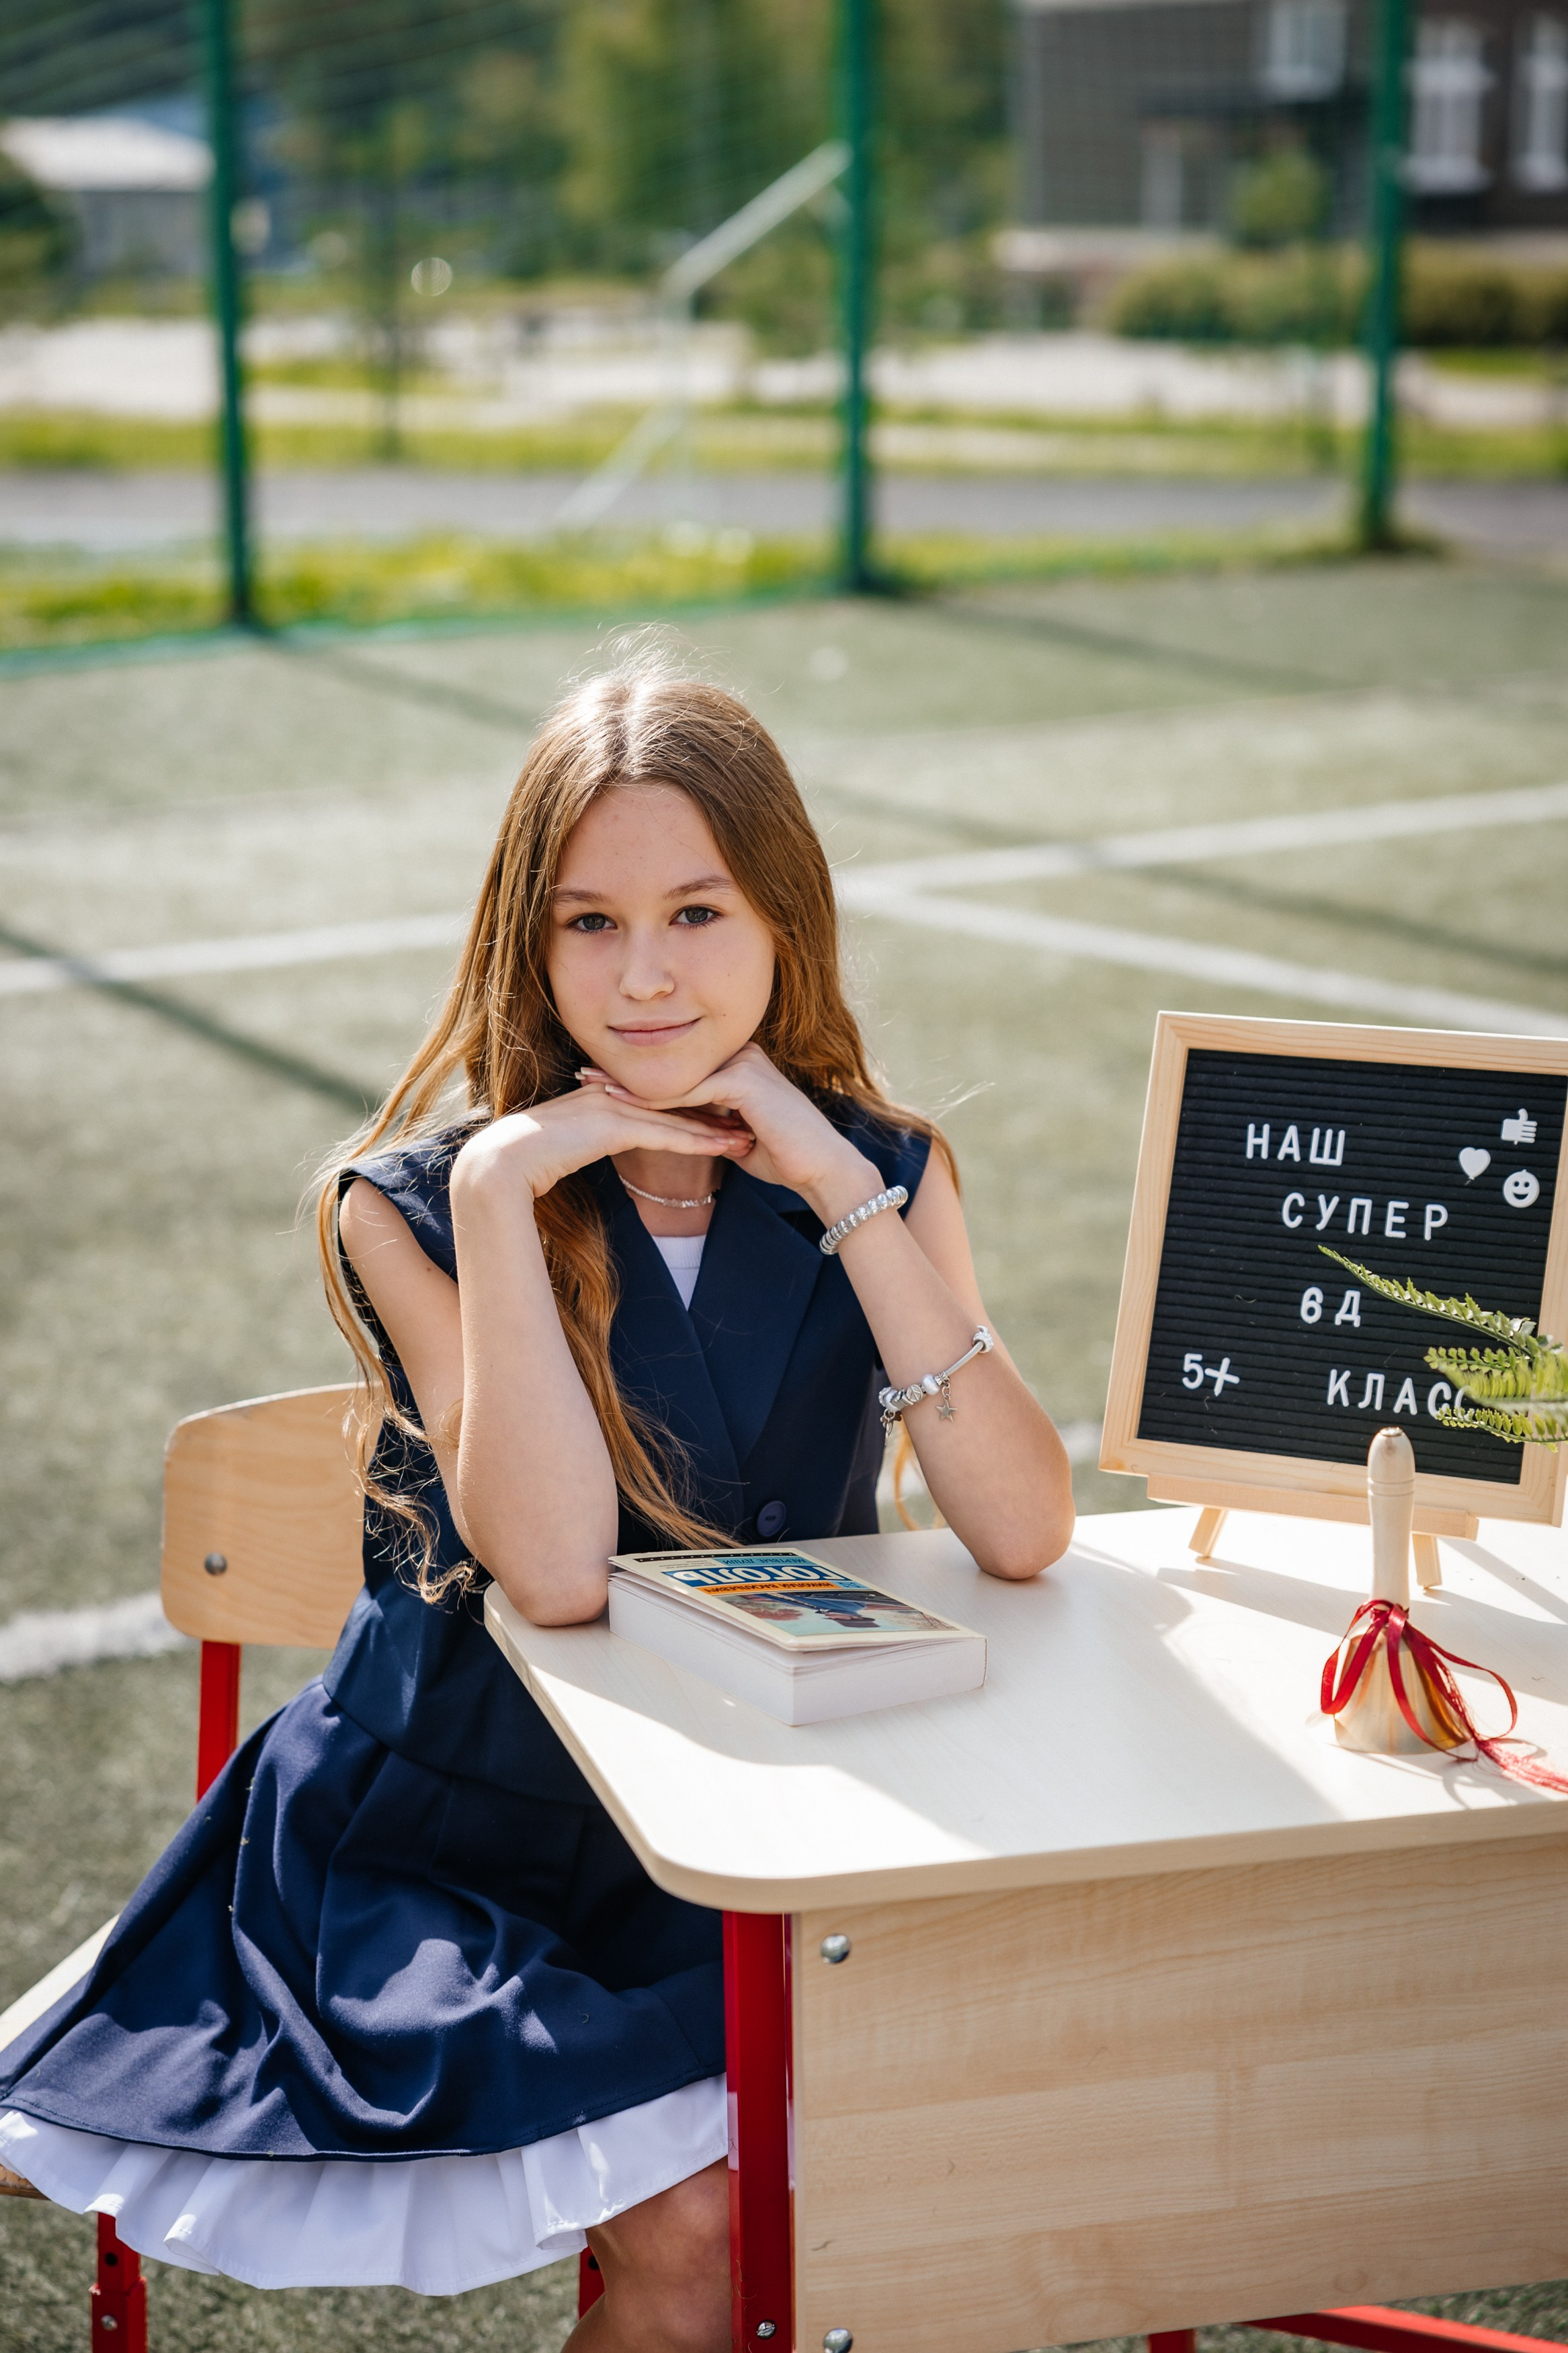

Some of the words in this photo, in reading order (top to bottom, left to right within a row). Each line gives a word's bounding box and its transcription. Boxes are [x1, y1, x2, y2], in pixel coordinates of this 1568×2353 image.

[1245, 1123, 1346, 1166] НАШ
[1282, 1192, 1448, 1240] СУПЕР
[1182, 1353, 1240, 1397] 5+
[673, 1566, 845, 1585] ГОГОЛЬ
[704, 1583, 780, 1593] ВАСИЛЬЕВИЧ
